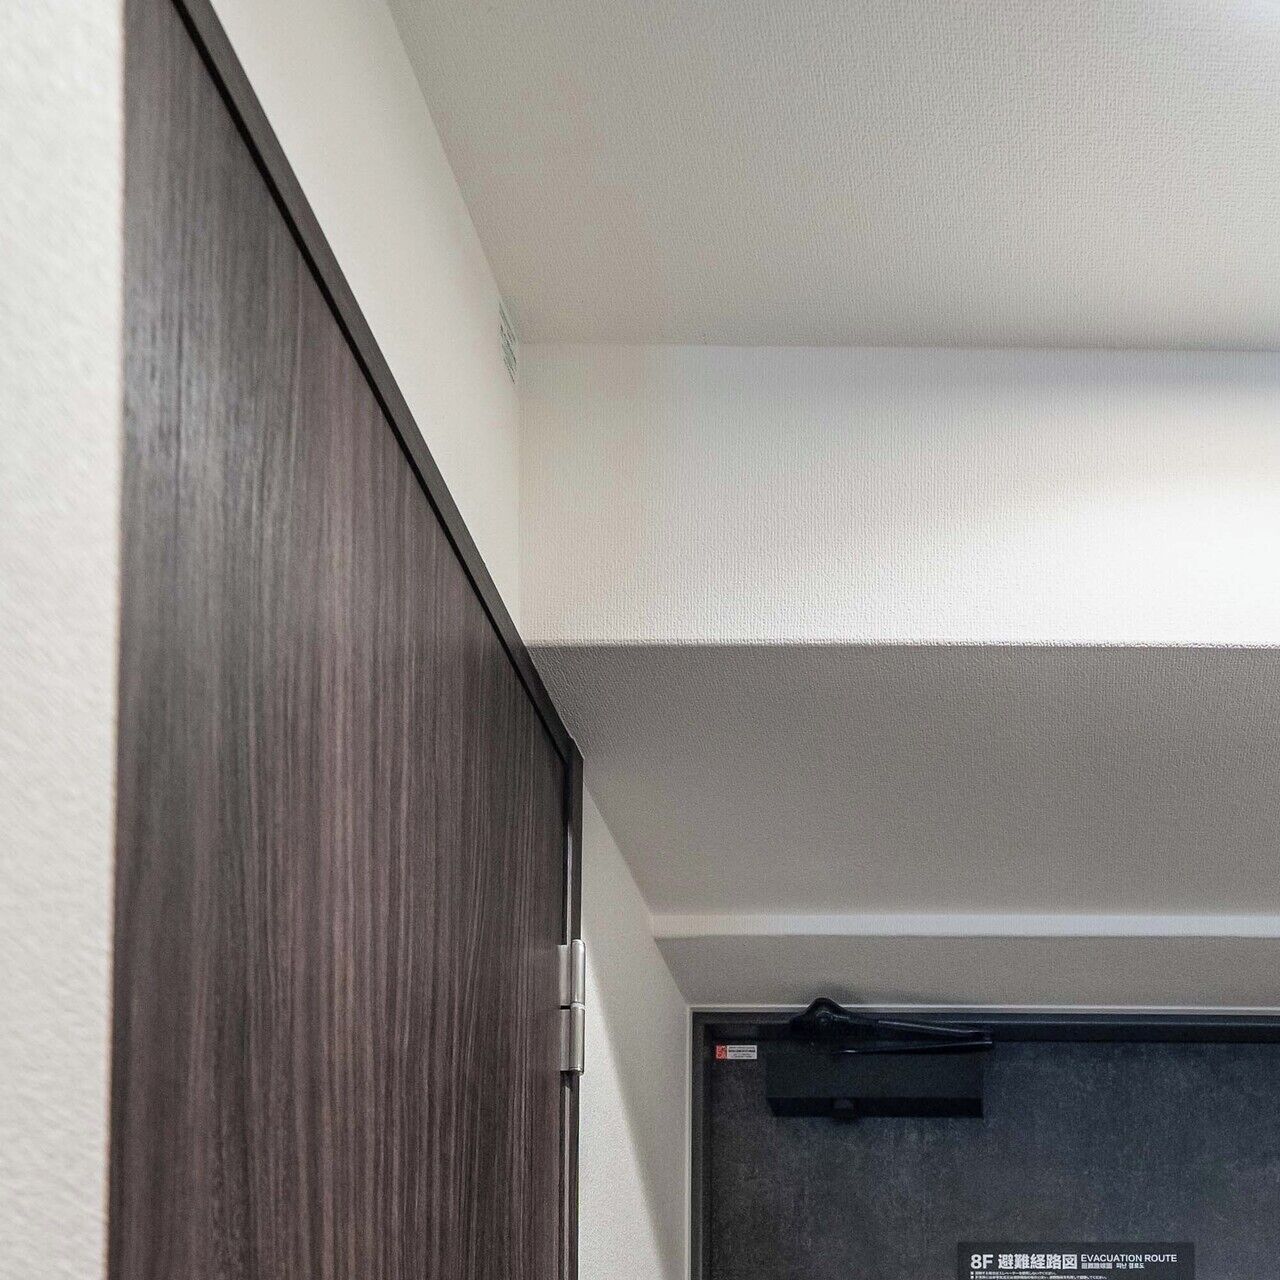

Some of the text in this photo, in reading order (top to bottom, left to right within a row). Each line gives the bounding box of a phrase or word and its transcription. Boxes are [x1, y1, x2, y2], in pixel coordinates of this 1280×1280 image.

[970, 1254, 994, 1270] 8F
[998, 1253, 1078, 1270] 避難経路図
[1081, 1254, 1178, 1263] EVACUATION ROUTE
